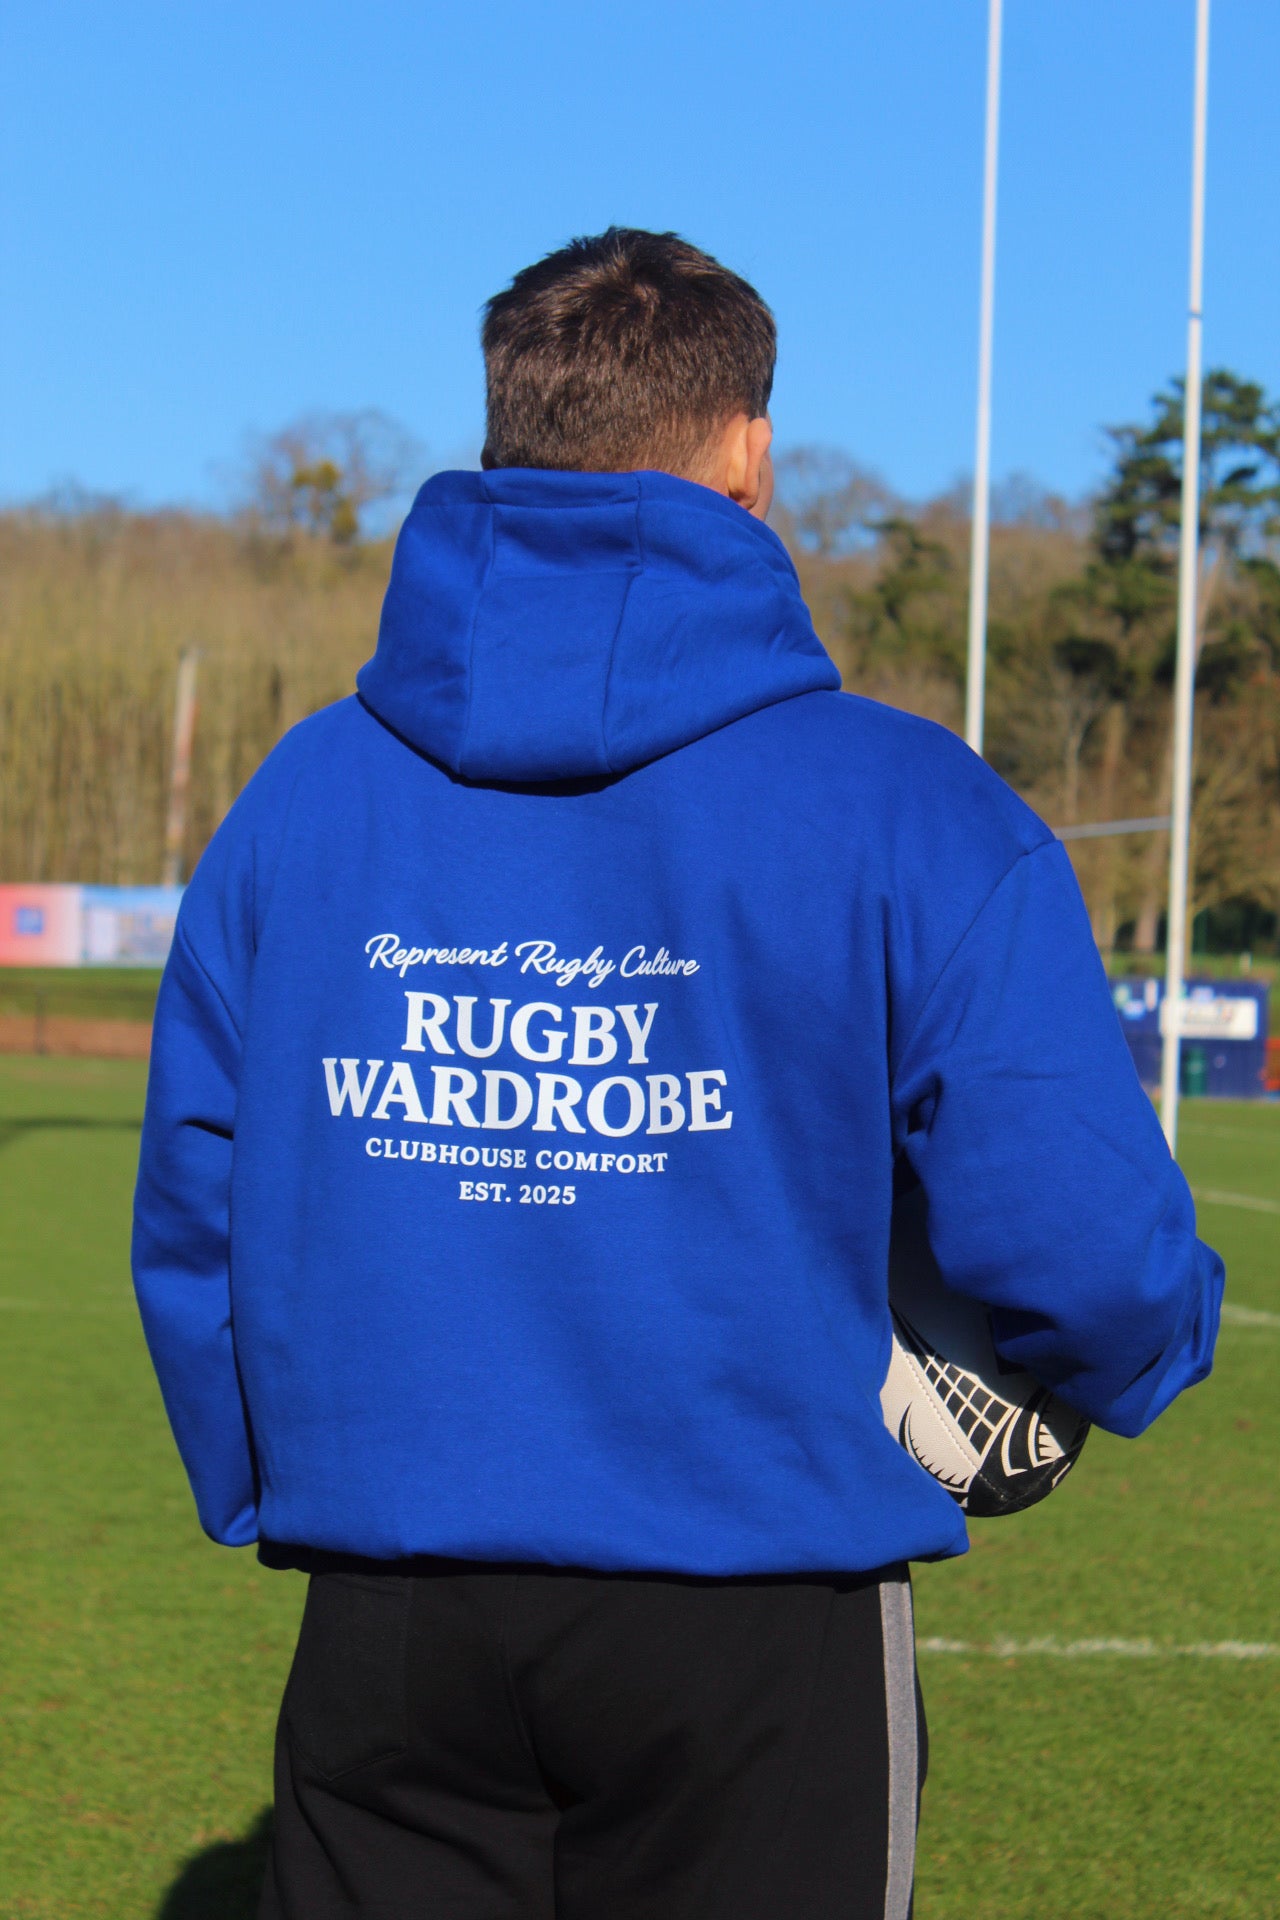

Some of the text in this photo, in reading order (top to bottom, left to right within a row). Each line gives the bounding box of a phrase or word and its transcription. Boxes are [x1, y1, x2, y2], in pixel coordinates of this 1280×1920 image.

[364, 933, 701, 988] Represent Rugby Culture
[401, 990, 659, 1066] RUGBY
[322, 1057, 733, 1138] WARDROBE
[365, 1137, 668, 1174] CLUBHOUSE COMFORT
[459, 1181, 577, 1205] EST. 2025
